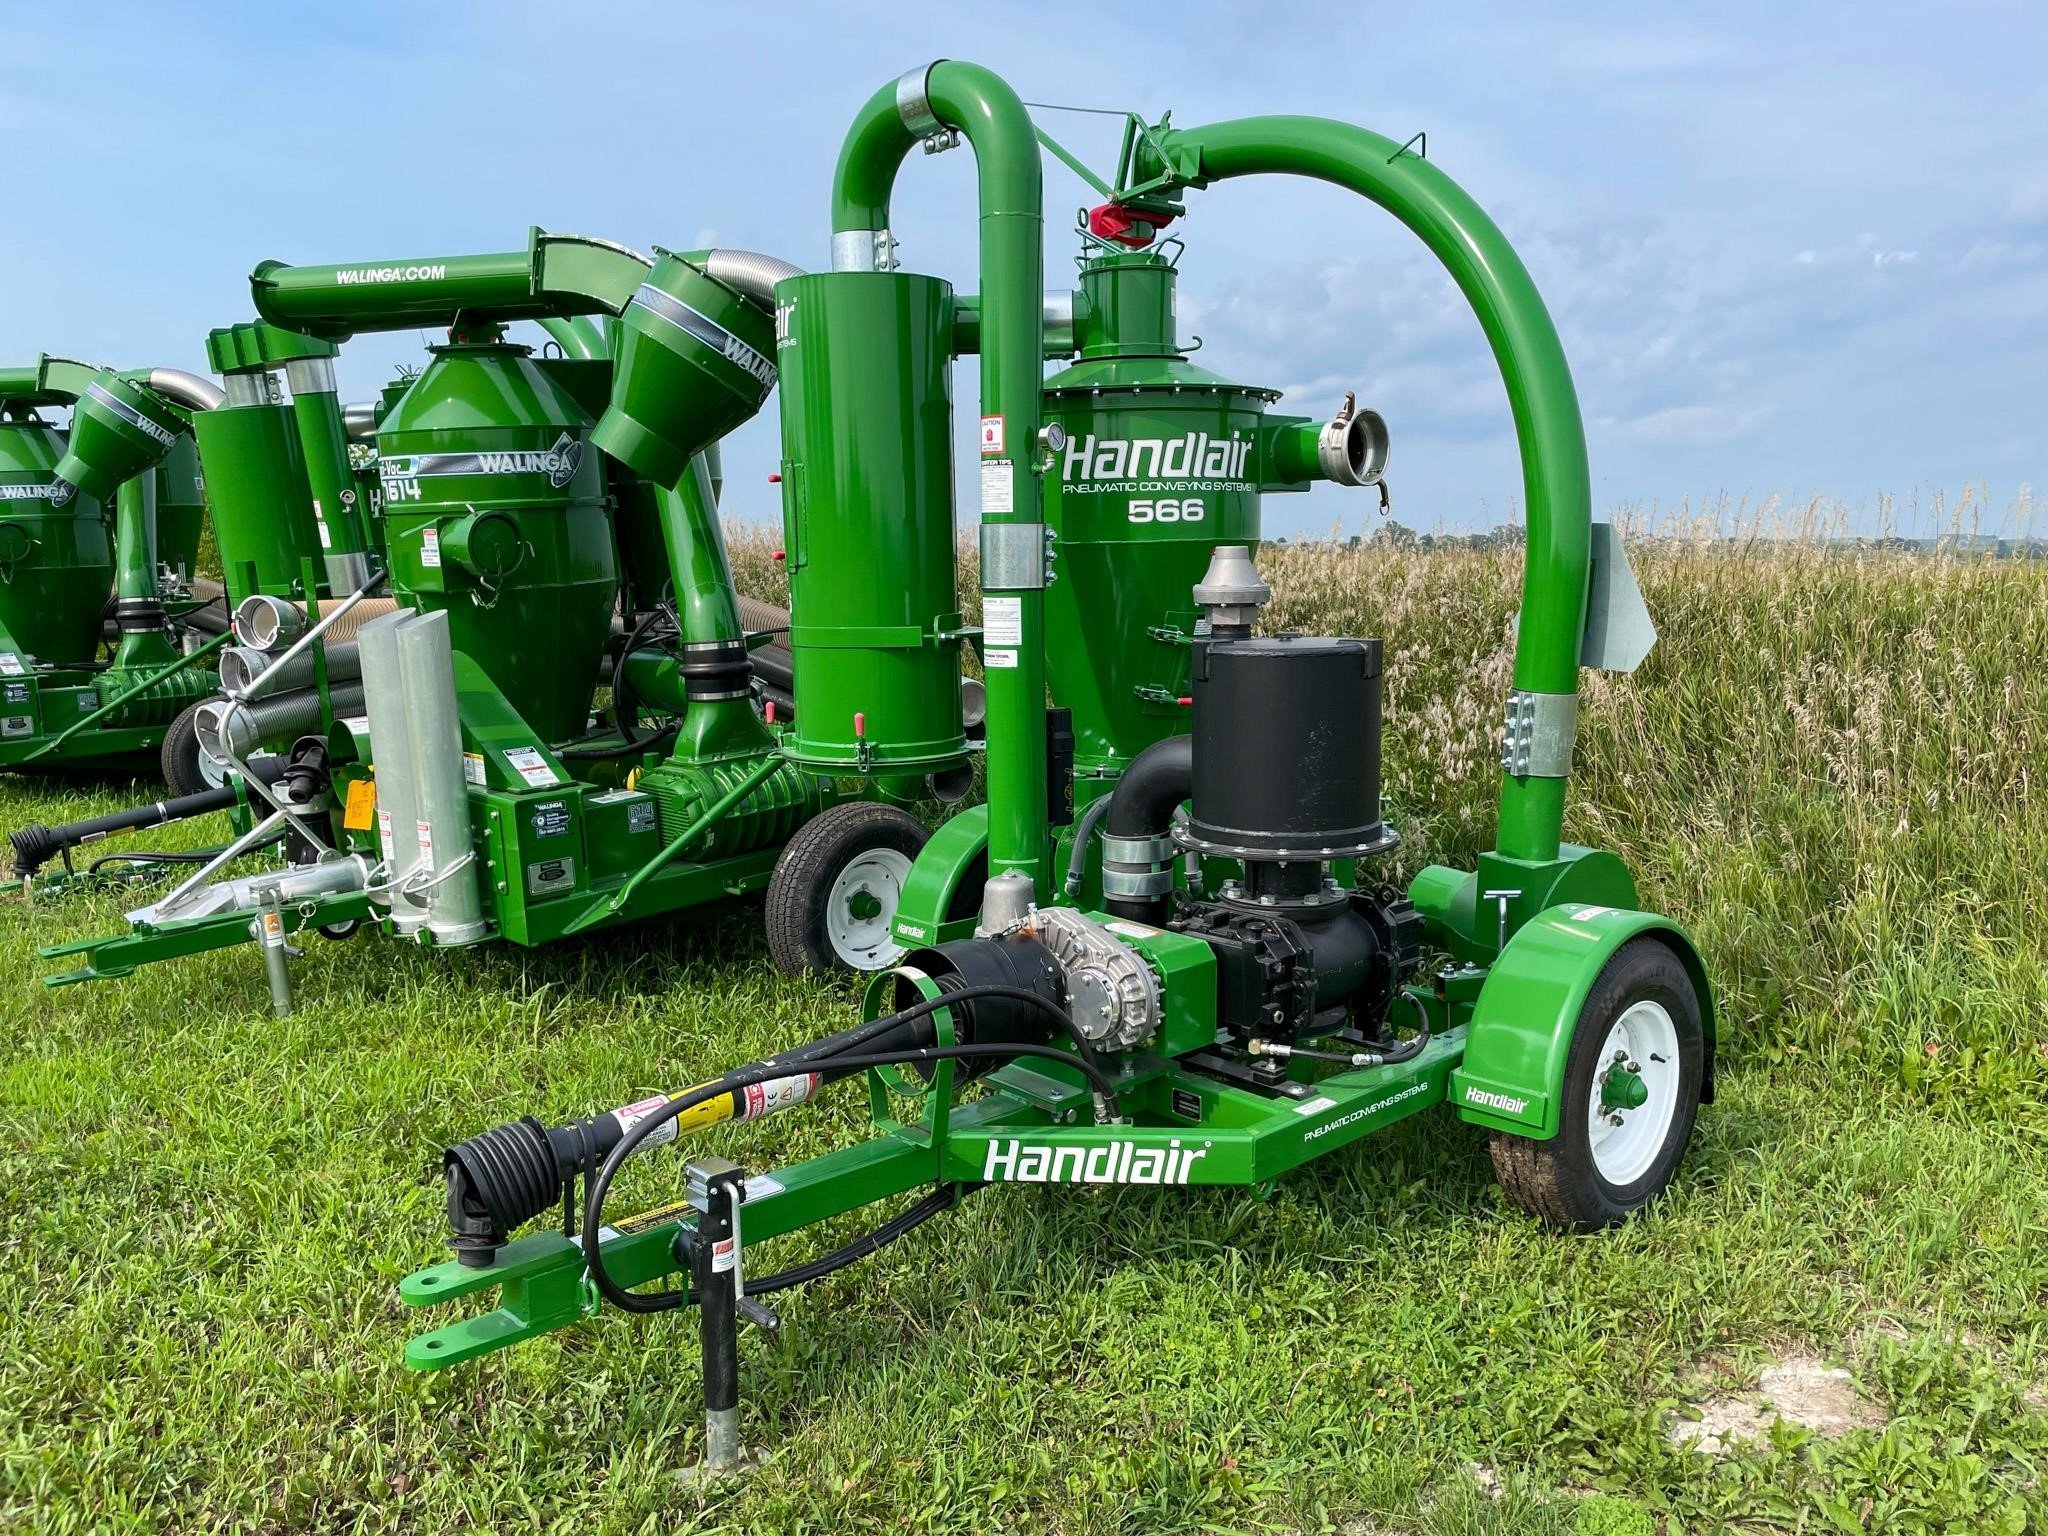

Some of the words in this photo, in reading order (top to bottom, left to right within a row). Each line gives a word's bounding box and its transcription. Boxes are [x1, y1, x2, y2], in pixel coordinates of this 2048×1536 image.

[724, 335, 778, 386] WALING
[478, 452, 573, 474] WALINGA
[1062, 431, 1253, 481] Handlair
[2, 486, 69, 500] WALINGA
[1063, 483, 1138, 494] PNEUMATIC
[1139, 481, 1213, 492] CONVEYING
[1213, 482, 1252, 493] SYSTEMS
[1127, 498, 1205, 524] 566
[1304, 1115, 1350, 1143] PNEUMATIC
[1350, 1097, 1394, 1122] CONVEYING
[1393, 1081, 1429, 1104] SYSTEMS
[1466, 1085, 1529, 1114] Handlair
[983, 1138, 1207, 1185] Handlair
